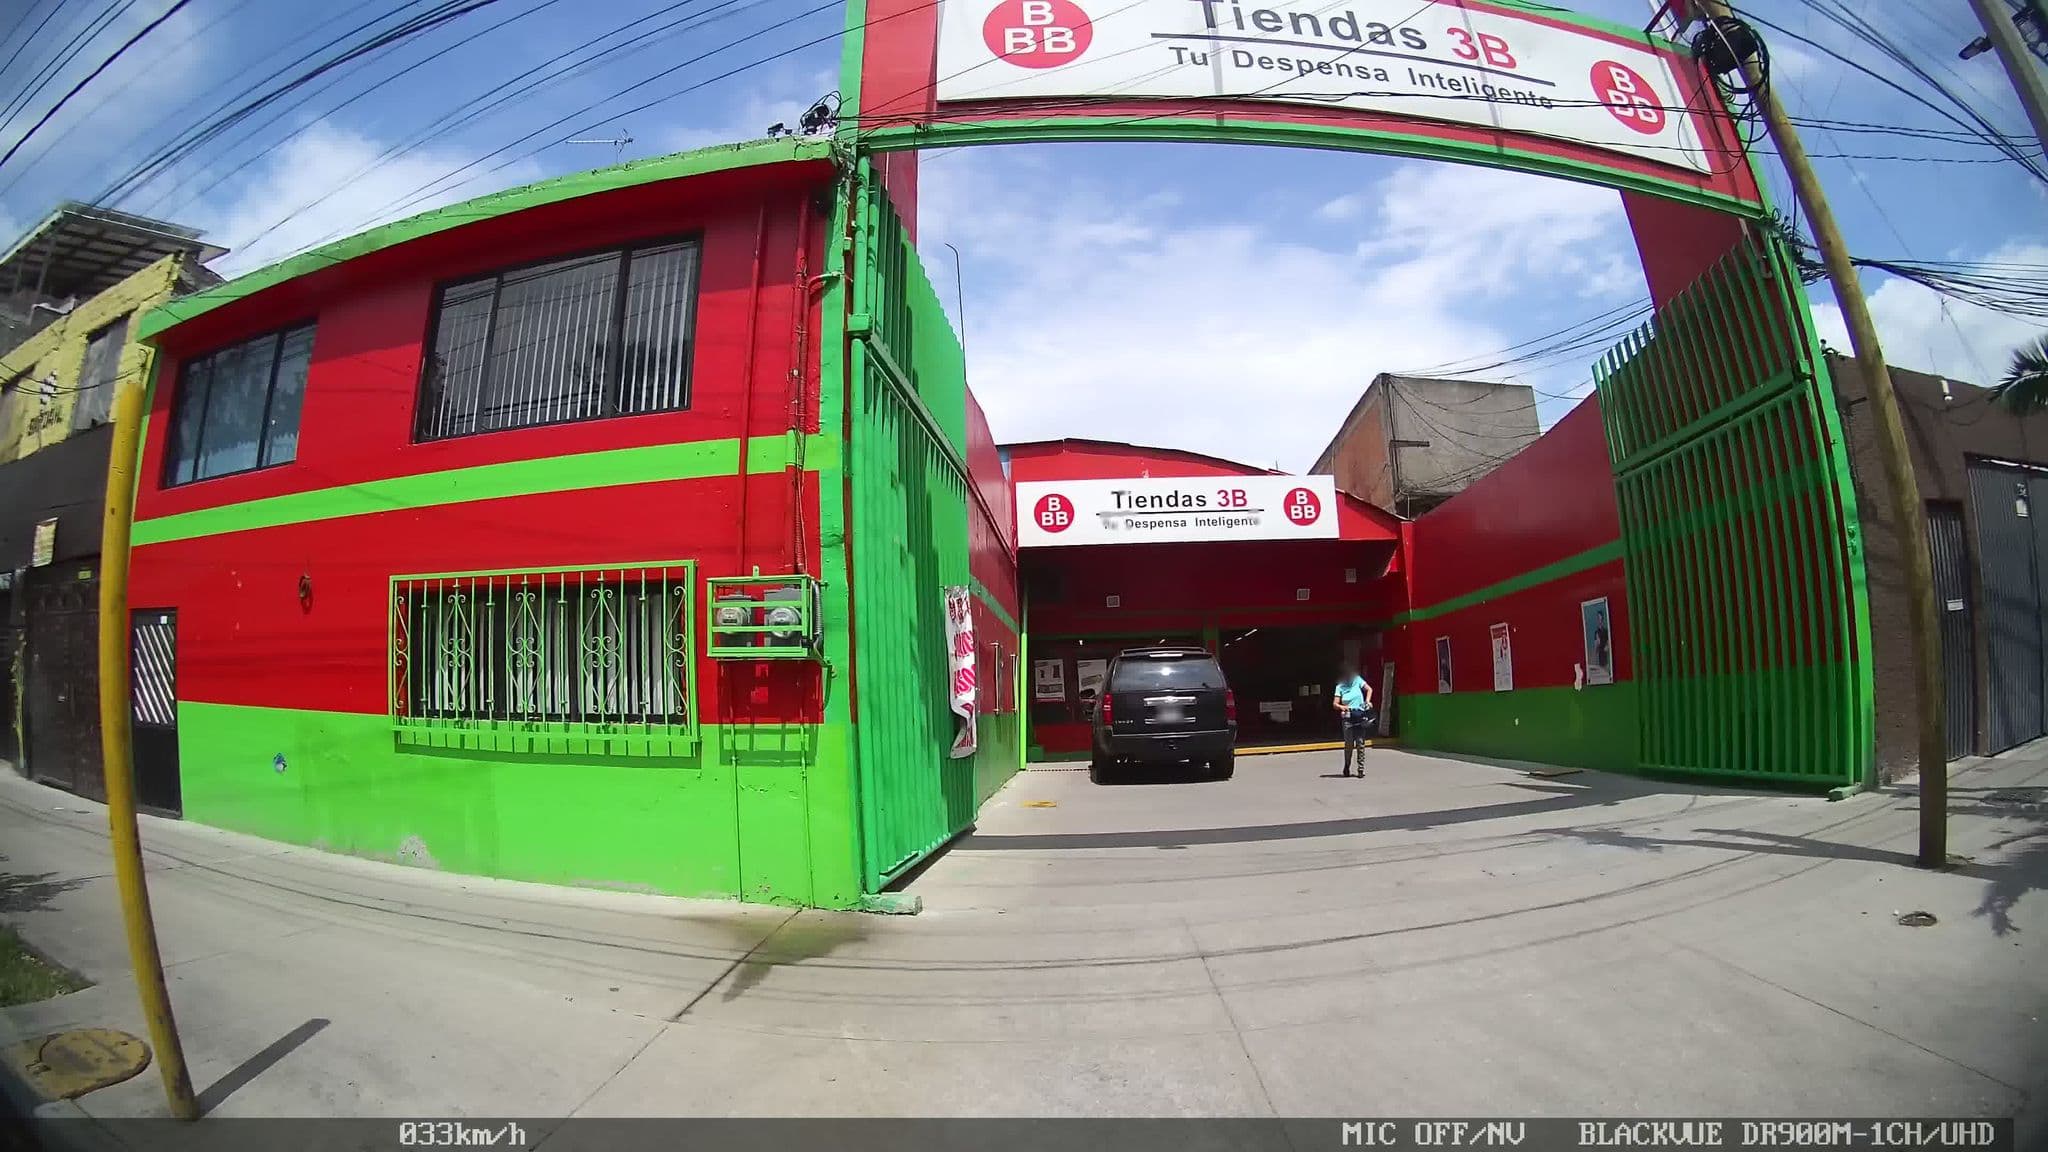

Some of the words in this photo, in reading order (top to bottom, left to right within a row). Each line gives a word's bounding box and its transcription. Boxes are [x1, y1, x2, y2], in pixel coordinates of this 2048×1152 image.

[1022, 0, 1054, 26] B
[1004, 27, 1076, 54] BB
[1192, 0, 1428, 50] Tiendas
[1446, 27, 1517, 69] 3B
[1168, 47, 1209, 66] Tu
[1232, 50, 1390, 82] Despensa
[1408, 67, 1553, 109] Inteligente
[1608, 66, 1636, 94] B
[1607, 90, 1659, 123] BB
[1047, 497, 1060, 512] B
[1111, 489, 1207, 509] Tiendas
[1216, 489, 1248, 507] 3B
[1296, 490, 1307, 504] B
[1041, 512, 1068, 526] BB
[1290, 505, 1316, 519] BB
[1125, 518, 1187, 530] Despensa
